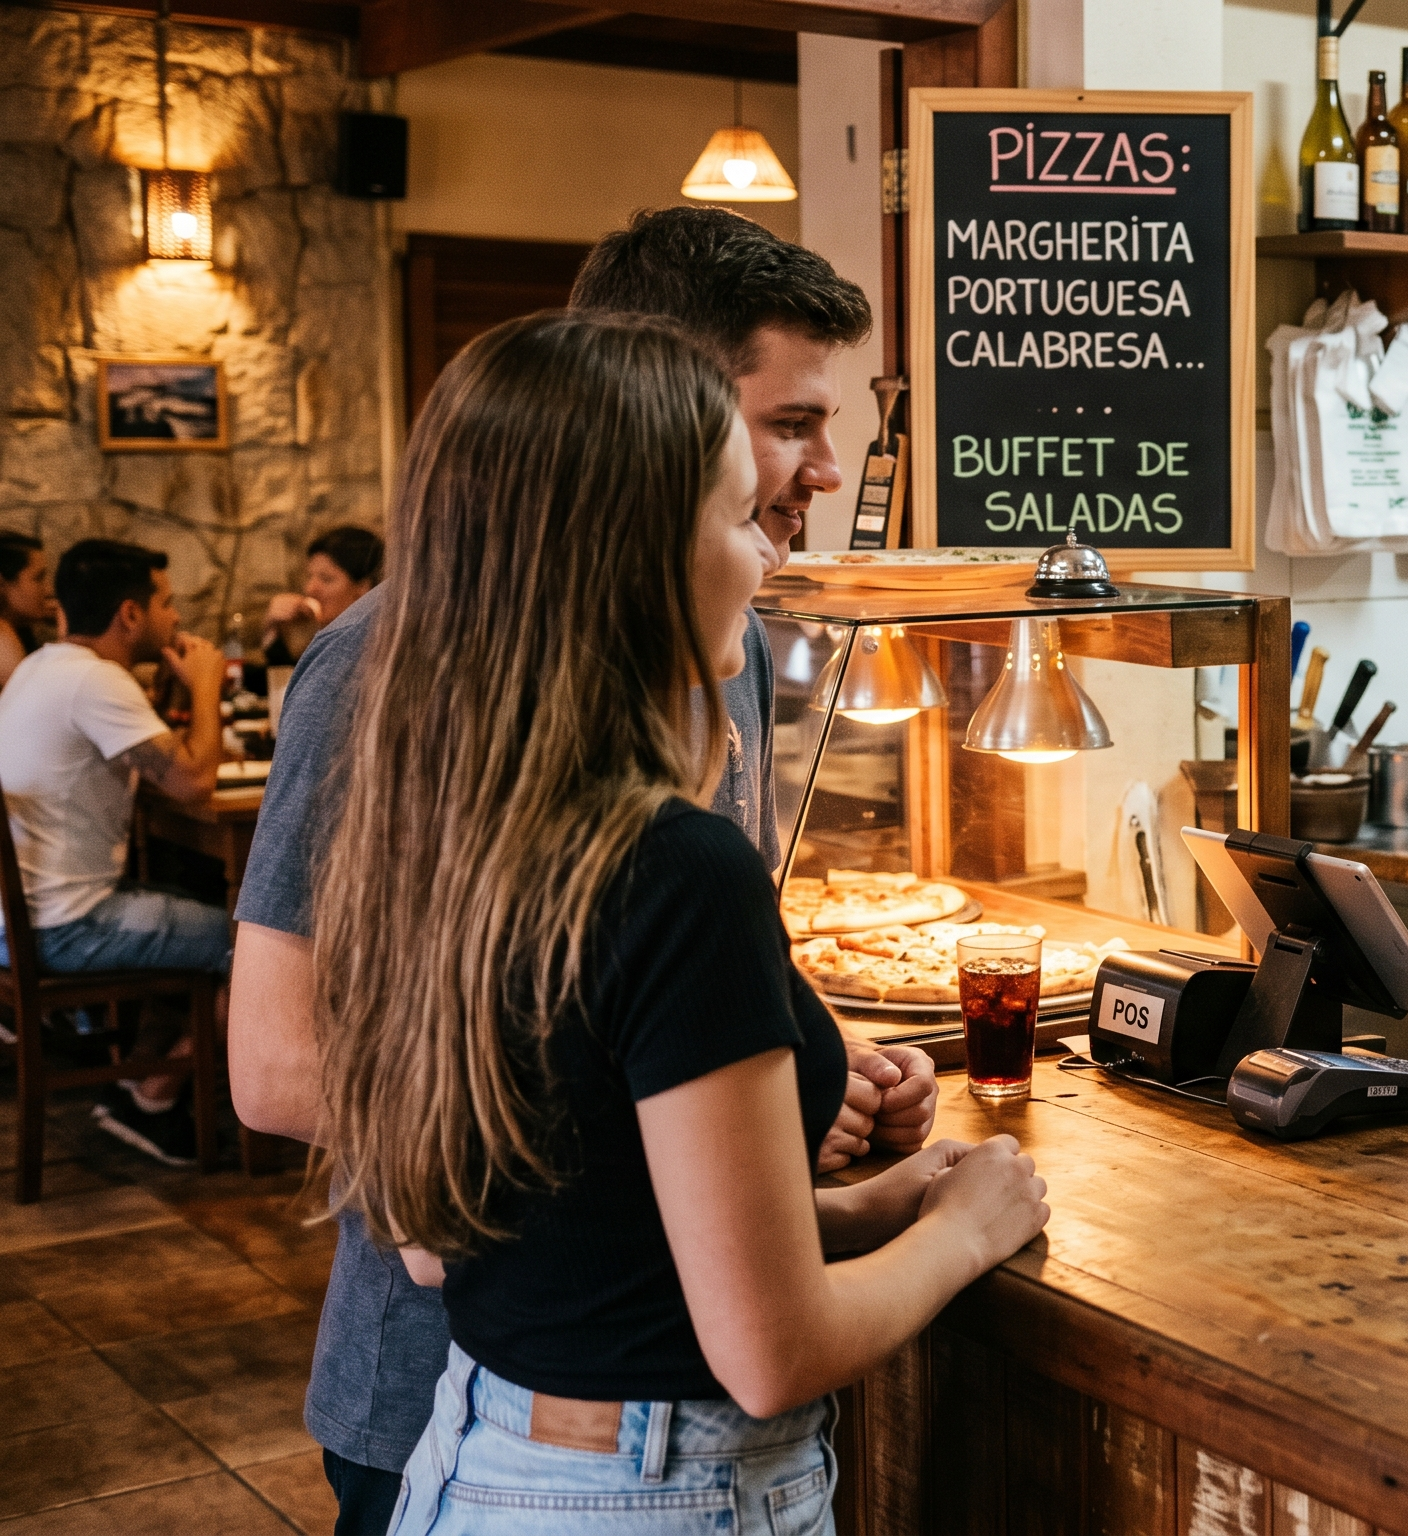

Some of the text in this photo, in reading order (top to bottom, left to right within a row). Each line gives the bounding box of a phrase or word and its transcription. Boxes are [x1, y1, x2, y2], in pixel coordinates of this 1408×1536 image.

[946, 215, 1195, 263] MARGHERITA
[947, 275, 1191, 318] PORTUGUESA
[946, 330, 1205, 369] CALABRESA...
[952, 435, 1190, 478] BUFFET DE
[984, 491, 1184, 534] SALADAS
[1112, 998, 1149, 1029] POS
